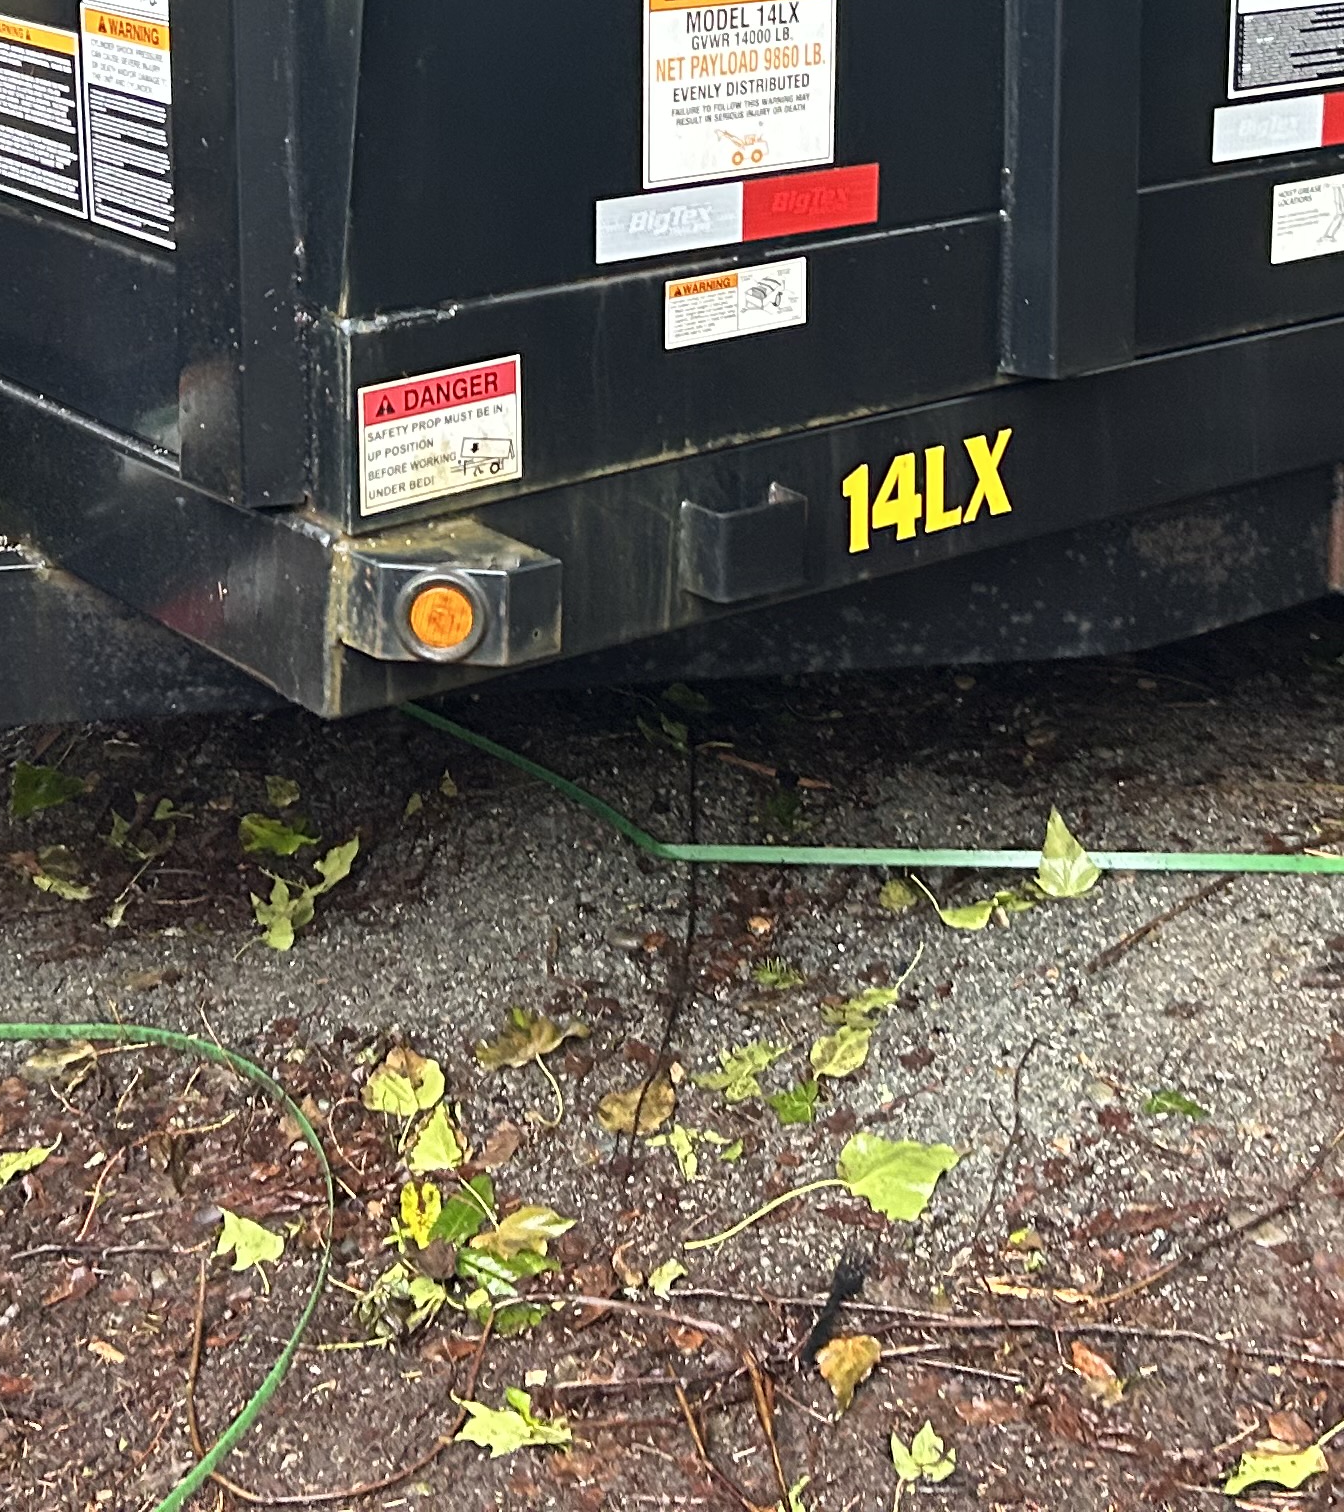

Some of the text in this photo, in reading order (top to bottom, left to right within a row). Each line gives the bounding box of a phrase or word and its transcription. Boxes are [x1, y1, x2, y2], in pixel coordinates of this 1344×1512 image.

[107, 17, 160, 46] WARNING
[686, 1, 800, 34] MODEL 14LX
[691, 32, 730, 51] GVWR
[734, 29, 771, 47] 14000
[655, 42, 826, 83] NET PAYLOAD 9860 LB.
[673, 72, 810, 103] EVENLY DISTRIBUTED
[682, 277, 732, 296] WARNING
[404, 371, 499, 411] DANGER
[367, 403, 504, 443] SAFETY PROP MUST BE IN
[367, 438, 435, 462] UP POSITION
[367, 451, 457, 482] BEFORE WORKING
[368, 482, 406, 501] UNDER
[842, 427, 1013, 554] 14LX
